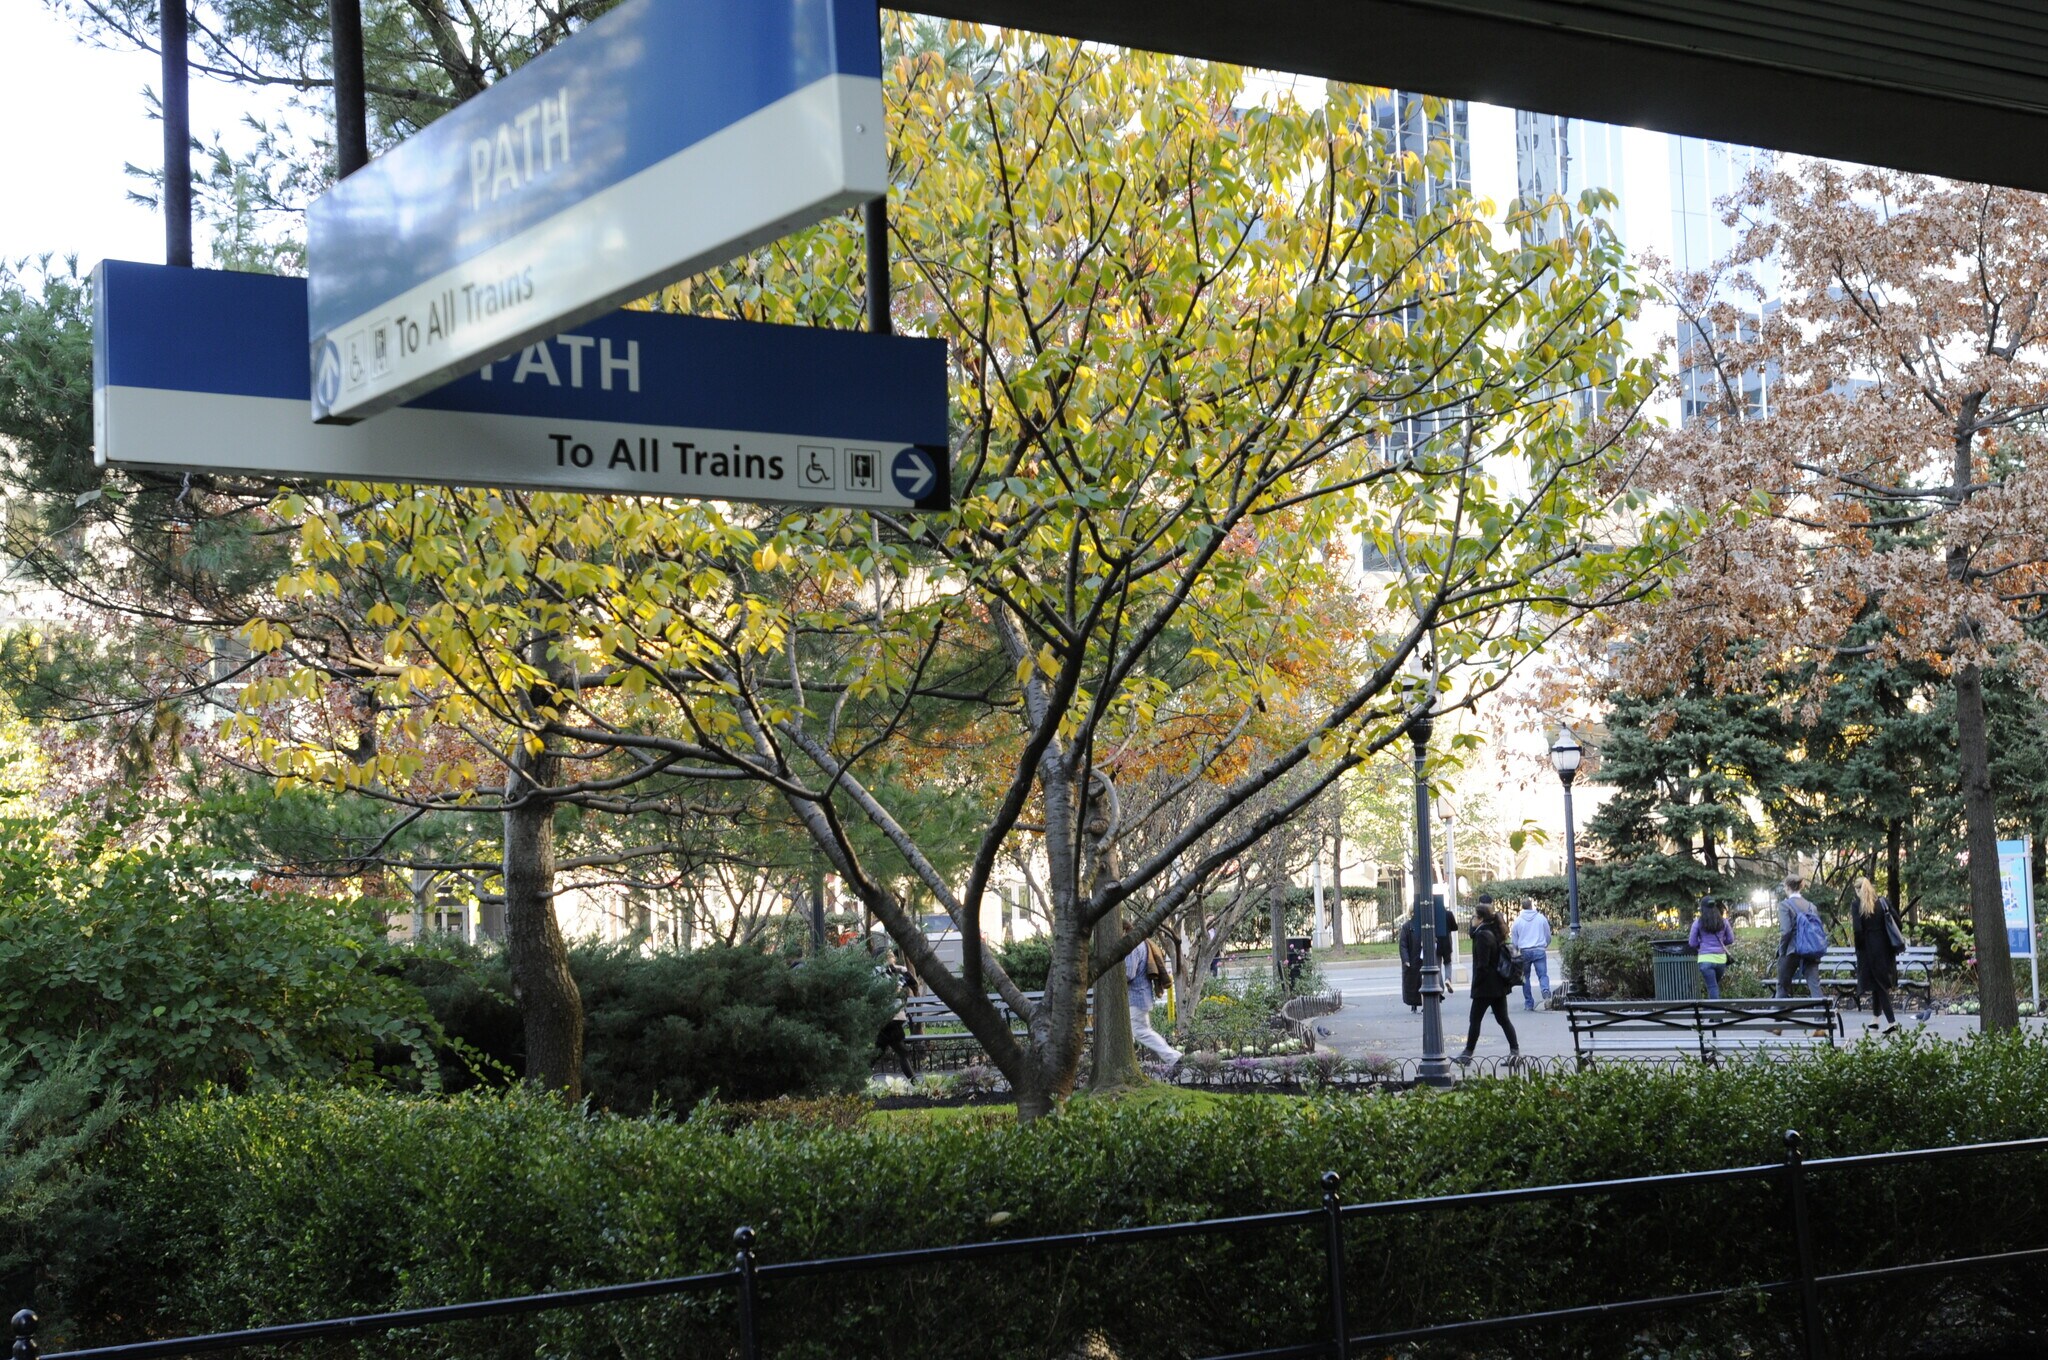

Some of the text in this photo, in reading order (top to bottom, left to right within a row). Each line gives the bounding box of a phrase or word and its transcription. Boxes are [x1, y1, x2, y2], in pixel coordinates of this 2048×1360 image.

[470, 87, 569, 211] PATH
[396, 265, 534, 357] To All Trains
[548, 434, 784, 481] To All Trains
